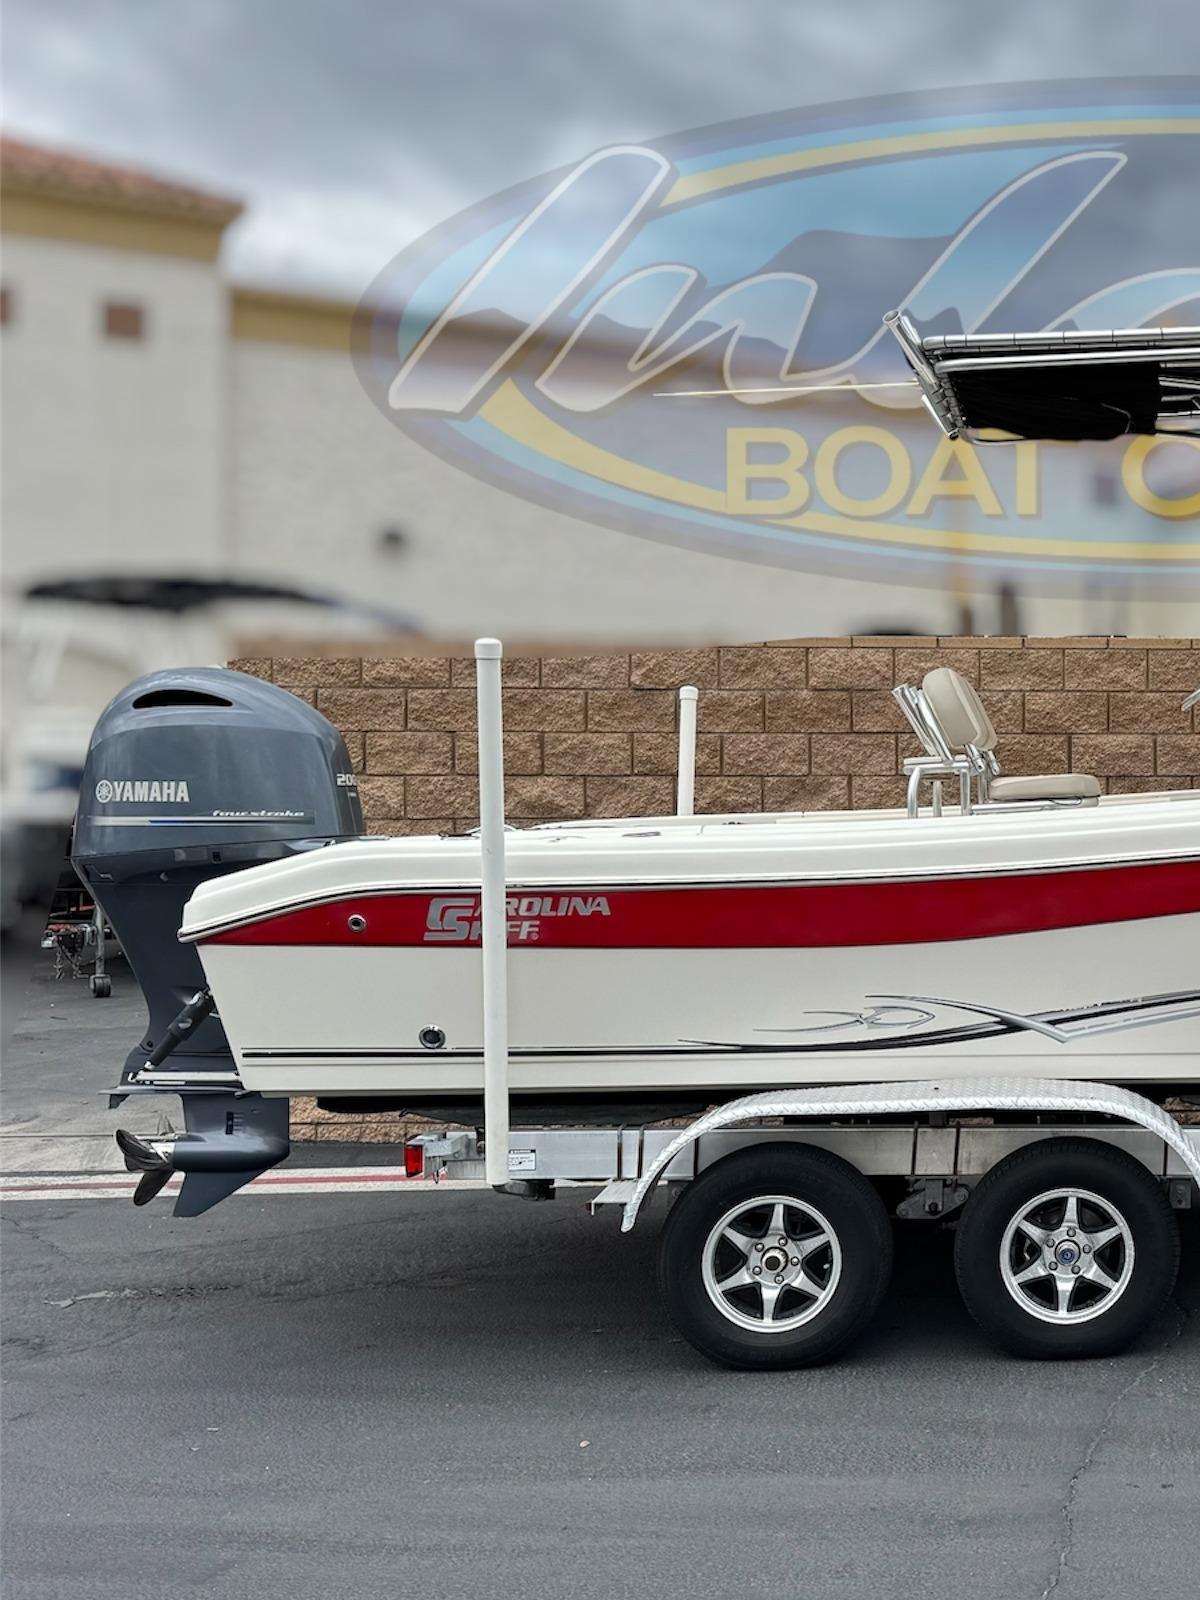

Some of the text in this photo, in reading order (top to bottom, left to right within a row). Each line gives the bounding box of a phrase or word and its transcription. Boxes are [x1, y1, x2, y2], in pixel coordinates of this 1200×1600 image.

[112, 780, 190, 802] YAMAHA
[336, 773, 357, 786] 20
[423, 908, 540, 941] SFF
[426, 896, 612, 931] CROLINA
